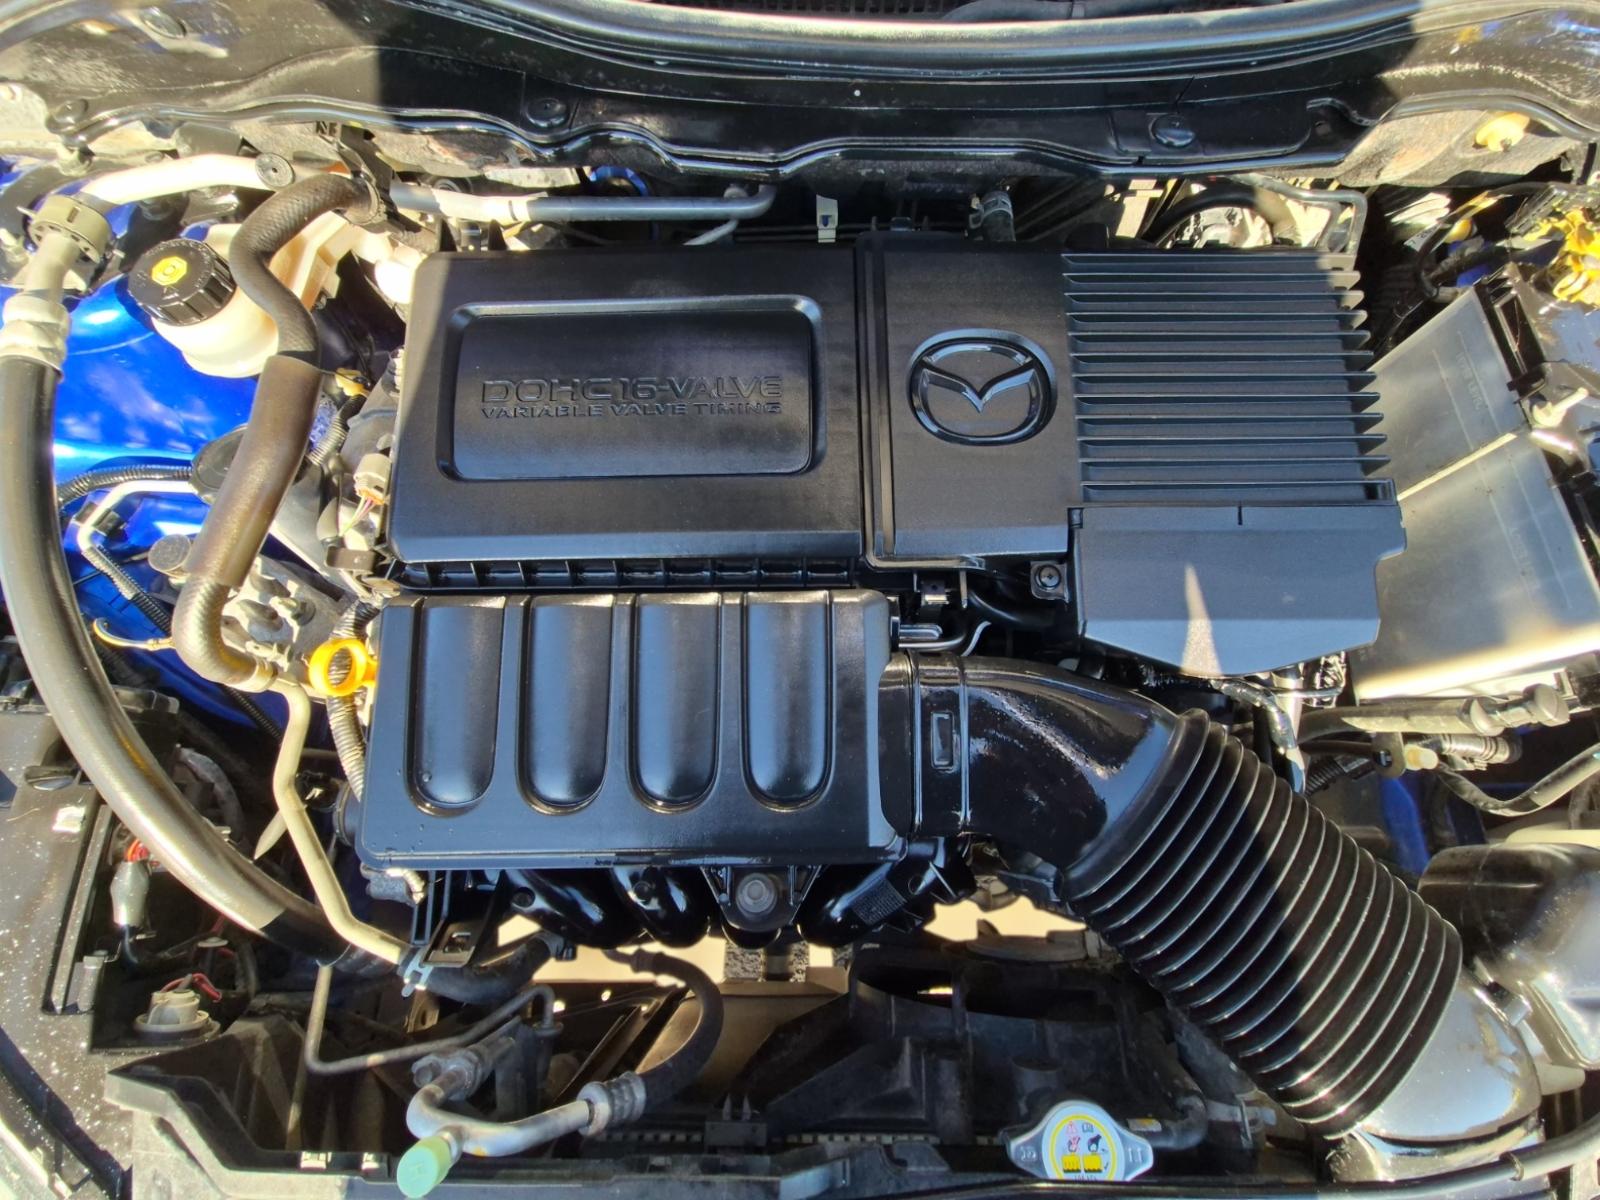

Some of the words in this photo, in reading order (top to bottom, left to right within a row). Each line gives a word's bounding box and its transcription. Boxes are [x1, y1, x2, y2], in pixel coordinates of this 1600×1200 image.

[481, 404, 603, 419] VARIABLE
[609, 403, 688, 417] VALVE
[692, 402, 783, 416] TIMING
